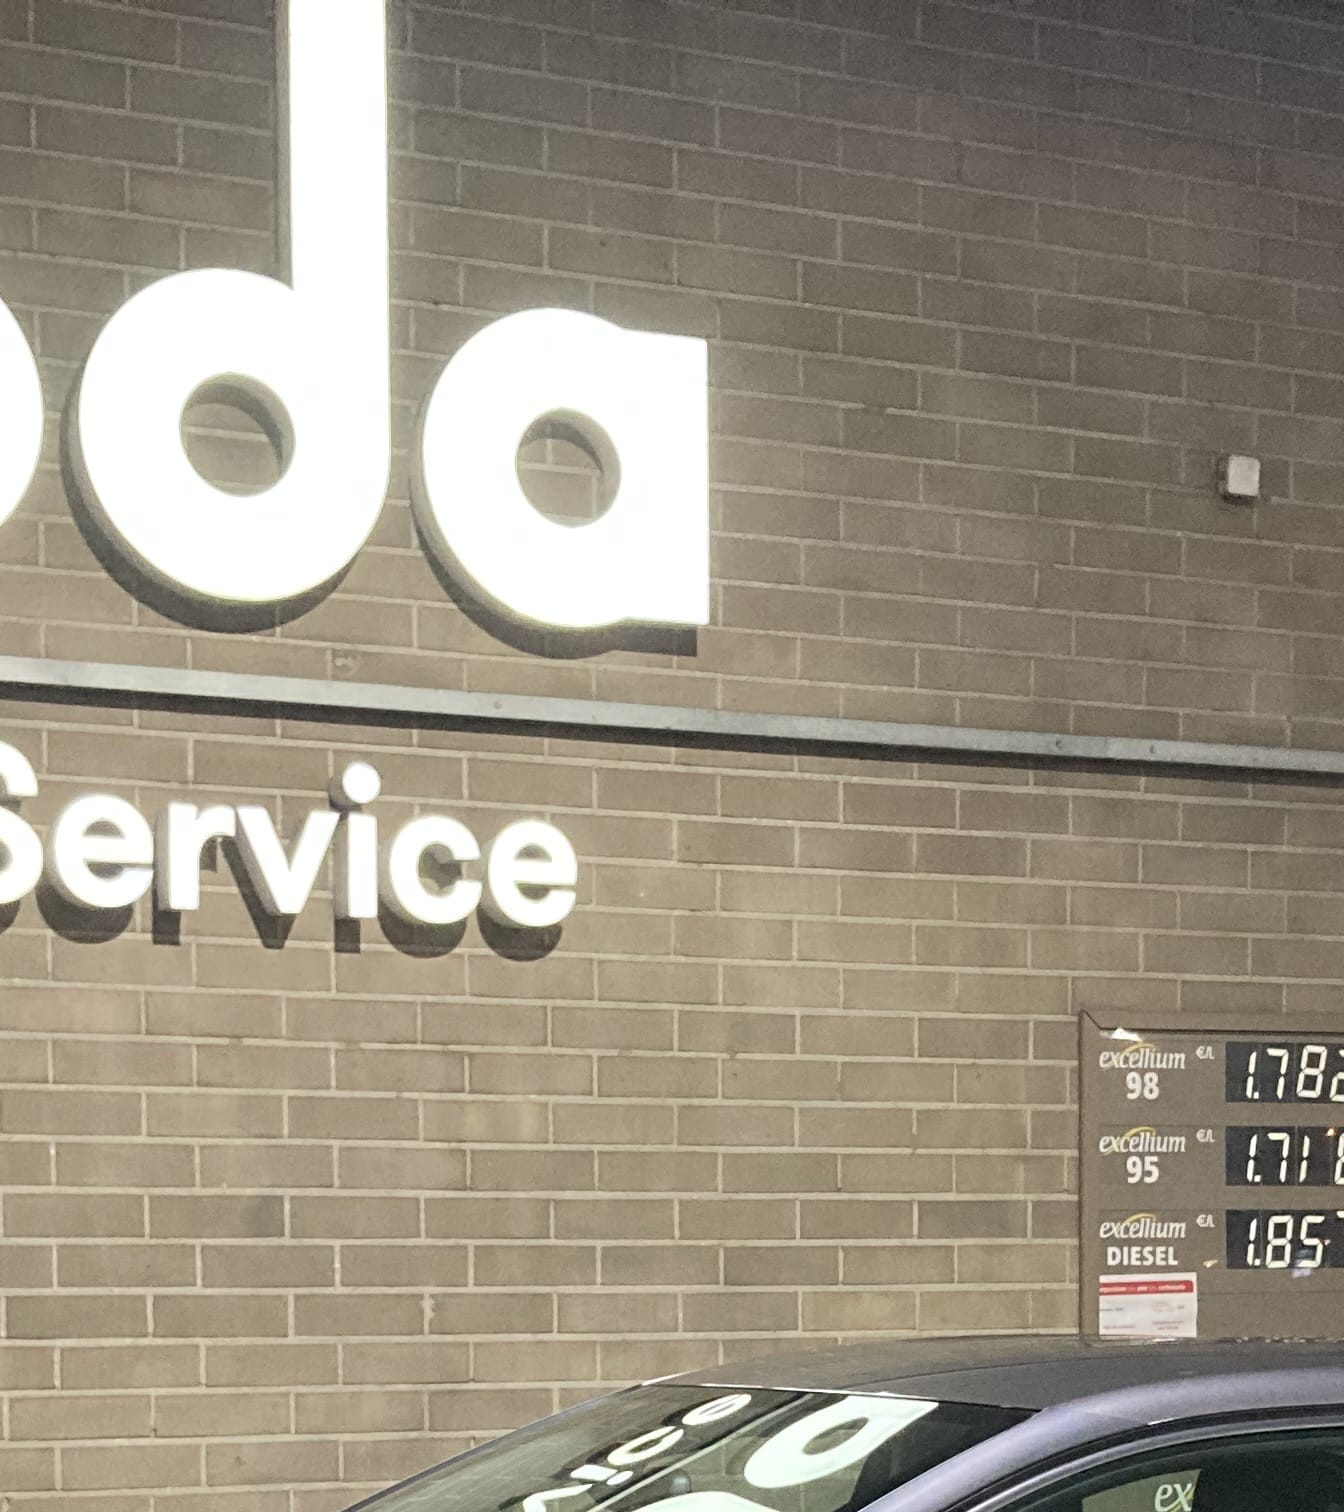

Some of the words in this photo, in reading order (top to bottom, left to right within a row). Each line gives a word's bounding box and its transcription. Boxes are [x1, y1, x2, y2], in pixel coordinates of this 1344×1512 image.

[1098, 1047, 1186, 1070] excellium
[1125, 1071, 1160, 1100] 98
[1098, 1131, 1186, 1154] excellium
[1125, 1155, 1160, 1184] 95
[1098, 1217, 1187, 1239] excellium
[1107, 1246, 1179, 1267] DIESEL
